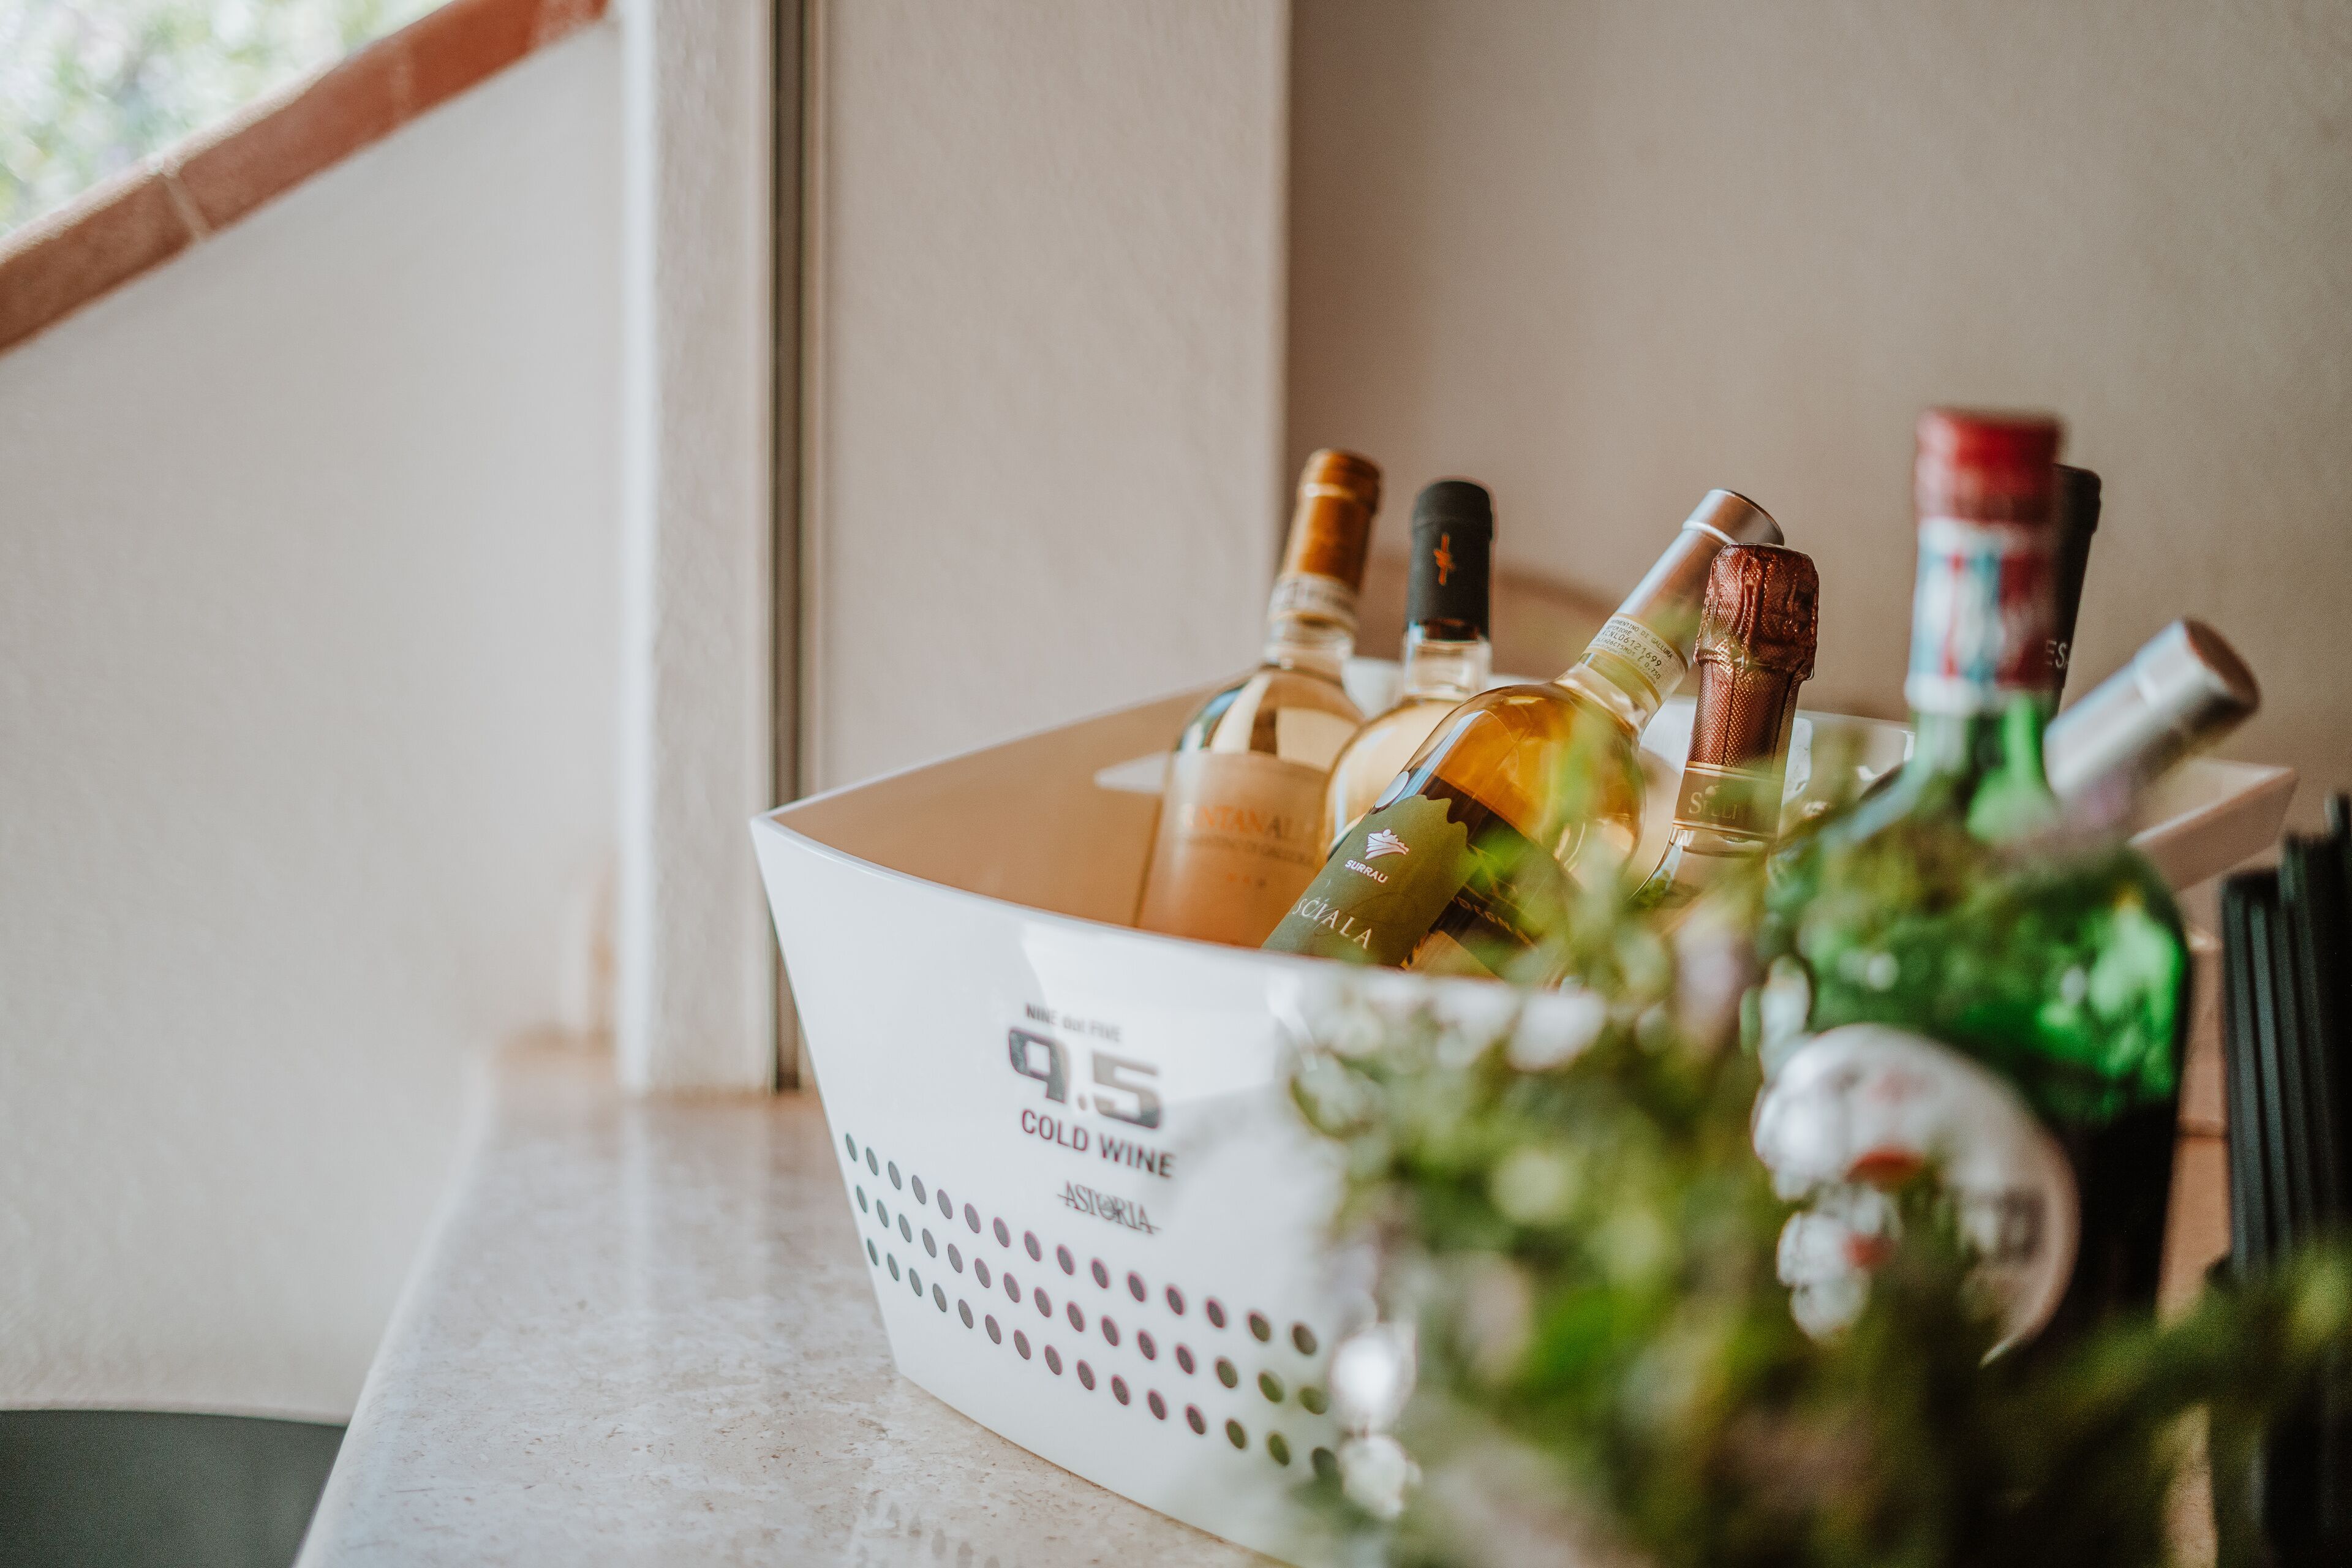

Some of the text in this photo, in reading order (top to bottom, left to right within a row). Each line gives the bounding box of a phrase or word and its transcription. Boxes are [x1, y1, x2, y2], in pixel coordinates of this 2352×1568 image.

[1640, 630, 1649, 639] DI
[1651, 637, 1673, 660] GALLURA
[1344, 859, 1389, 883] SURRAU
[1026, 1003, 1058, 1026] NINE
[1009, 1026, 1162, 1129] 9.5
[1022, 1109, 1177, 1179] COLD WINE
[1057, 1180, 1163, 1235] ASTORIA
